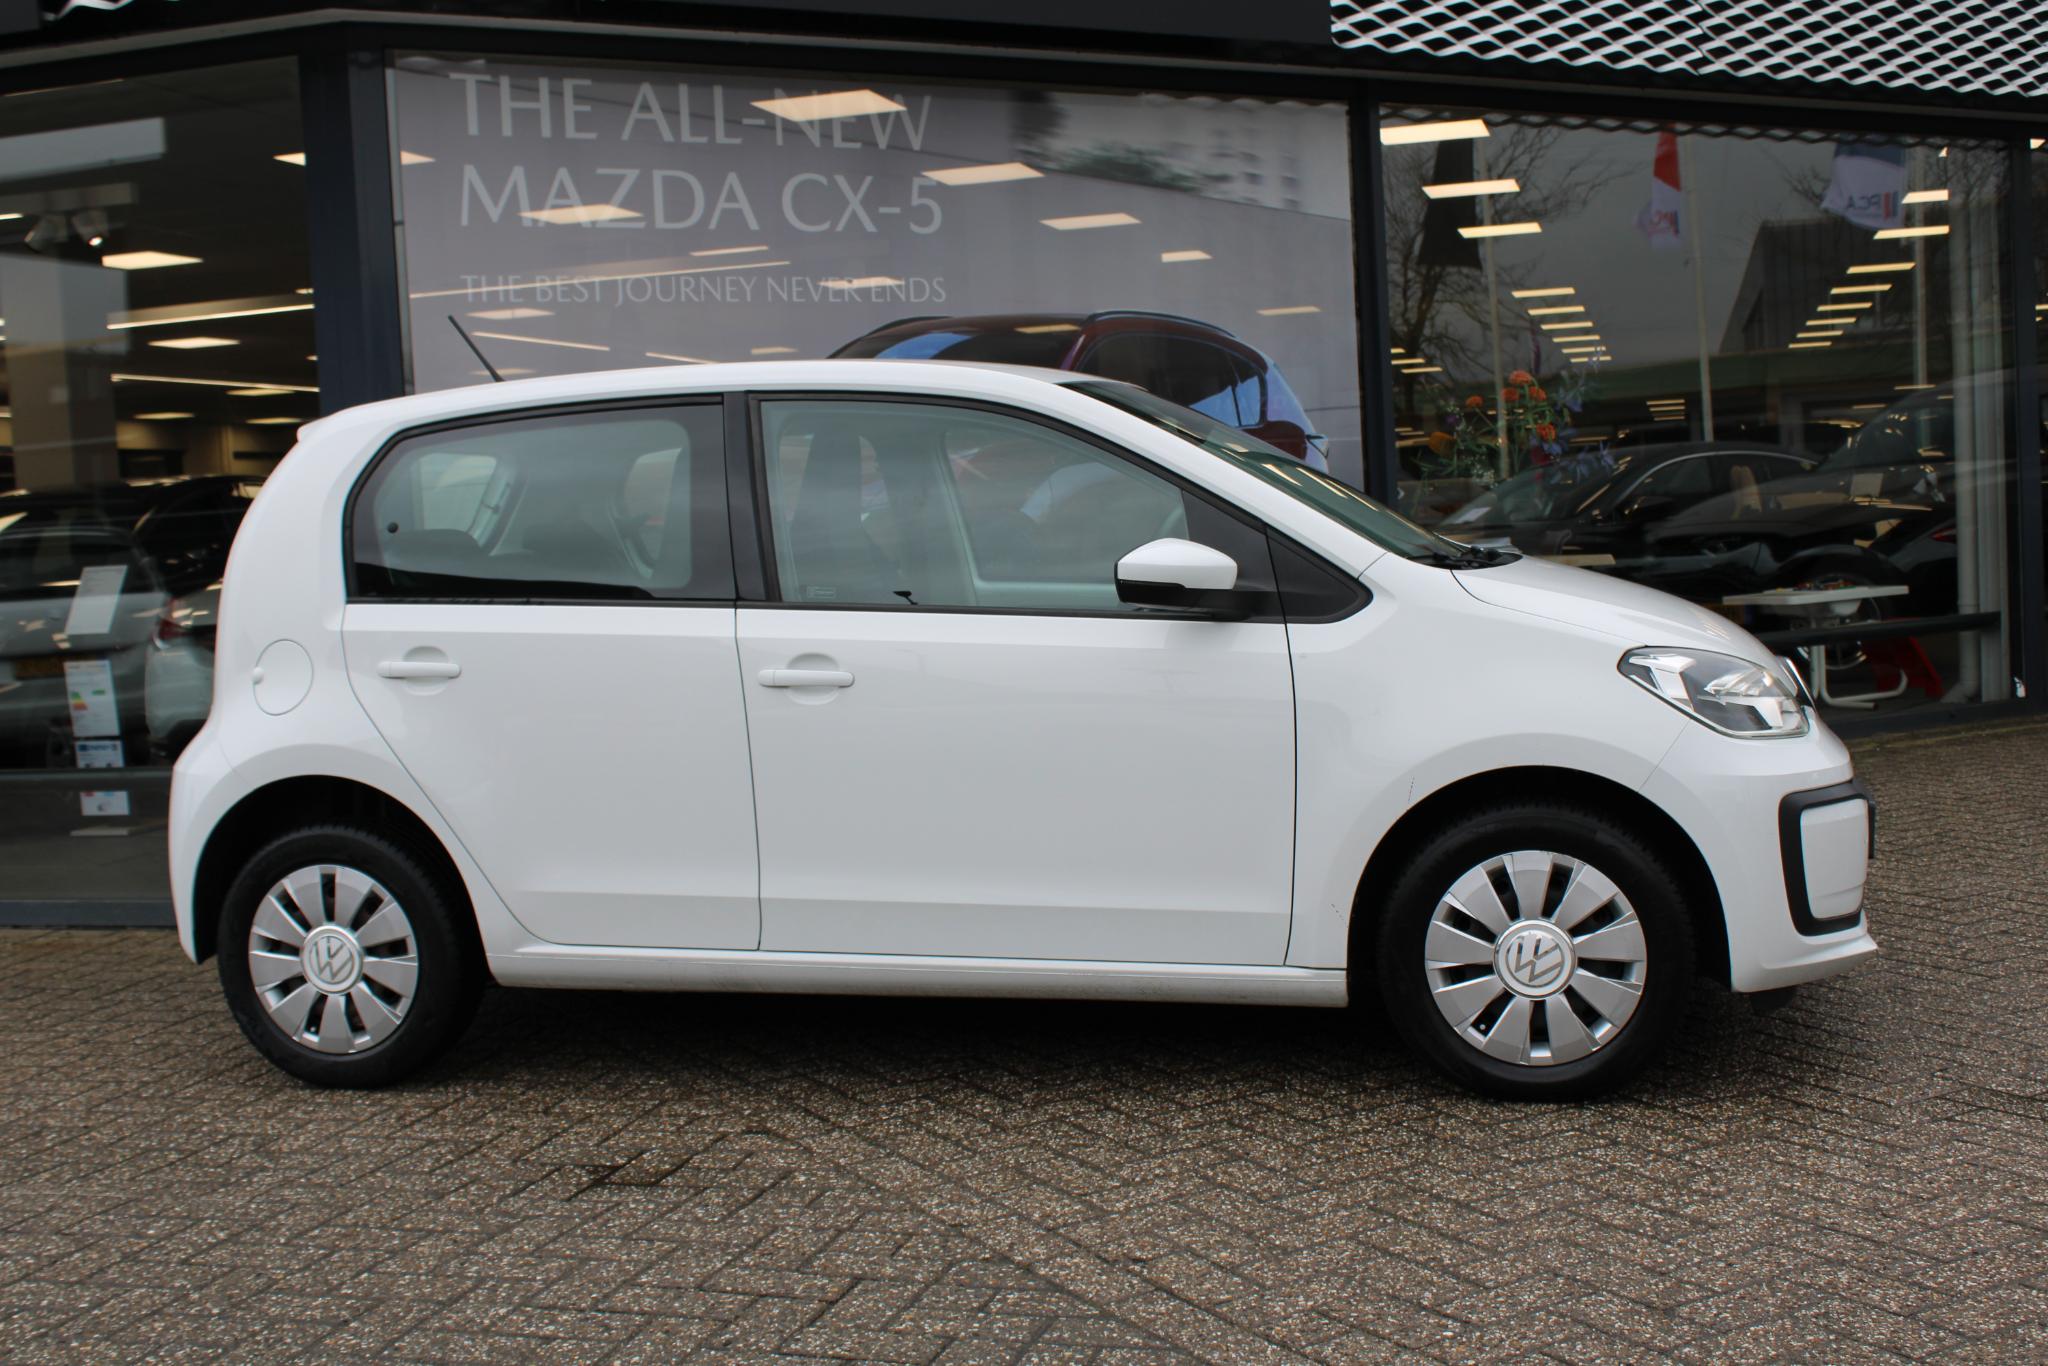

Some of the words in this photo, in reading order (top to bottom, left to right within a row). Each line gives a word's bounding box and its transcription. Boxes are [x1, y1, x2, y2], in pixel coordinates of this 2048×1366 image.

[450, 73, 597, 139] THE
[622, 82, 932, 151] ALL-NEW
[460, 164, 760, 230] MAZDA
[782, 172, 943, 234] CX-5
[460, 275, 521, 302] THE
[535, 275, 602, 302] BEST
[614, 276, 758, 306] JOURNEY
[767, 277, 861, 303] NEVER
[871, 277, 947, 303] ENDS
